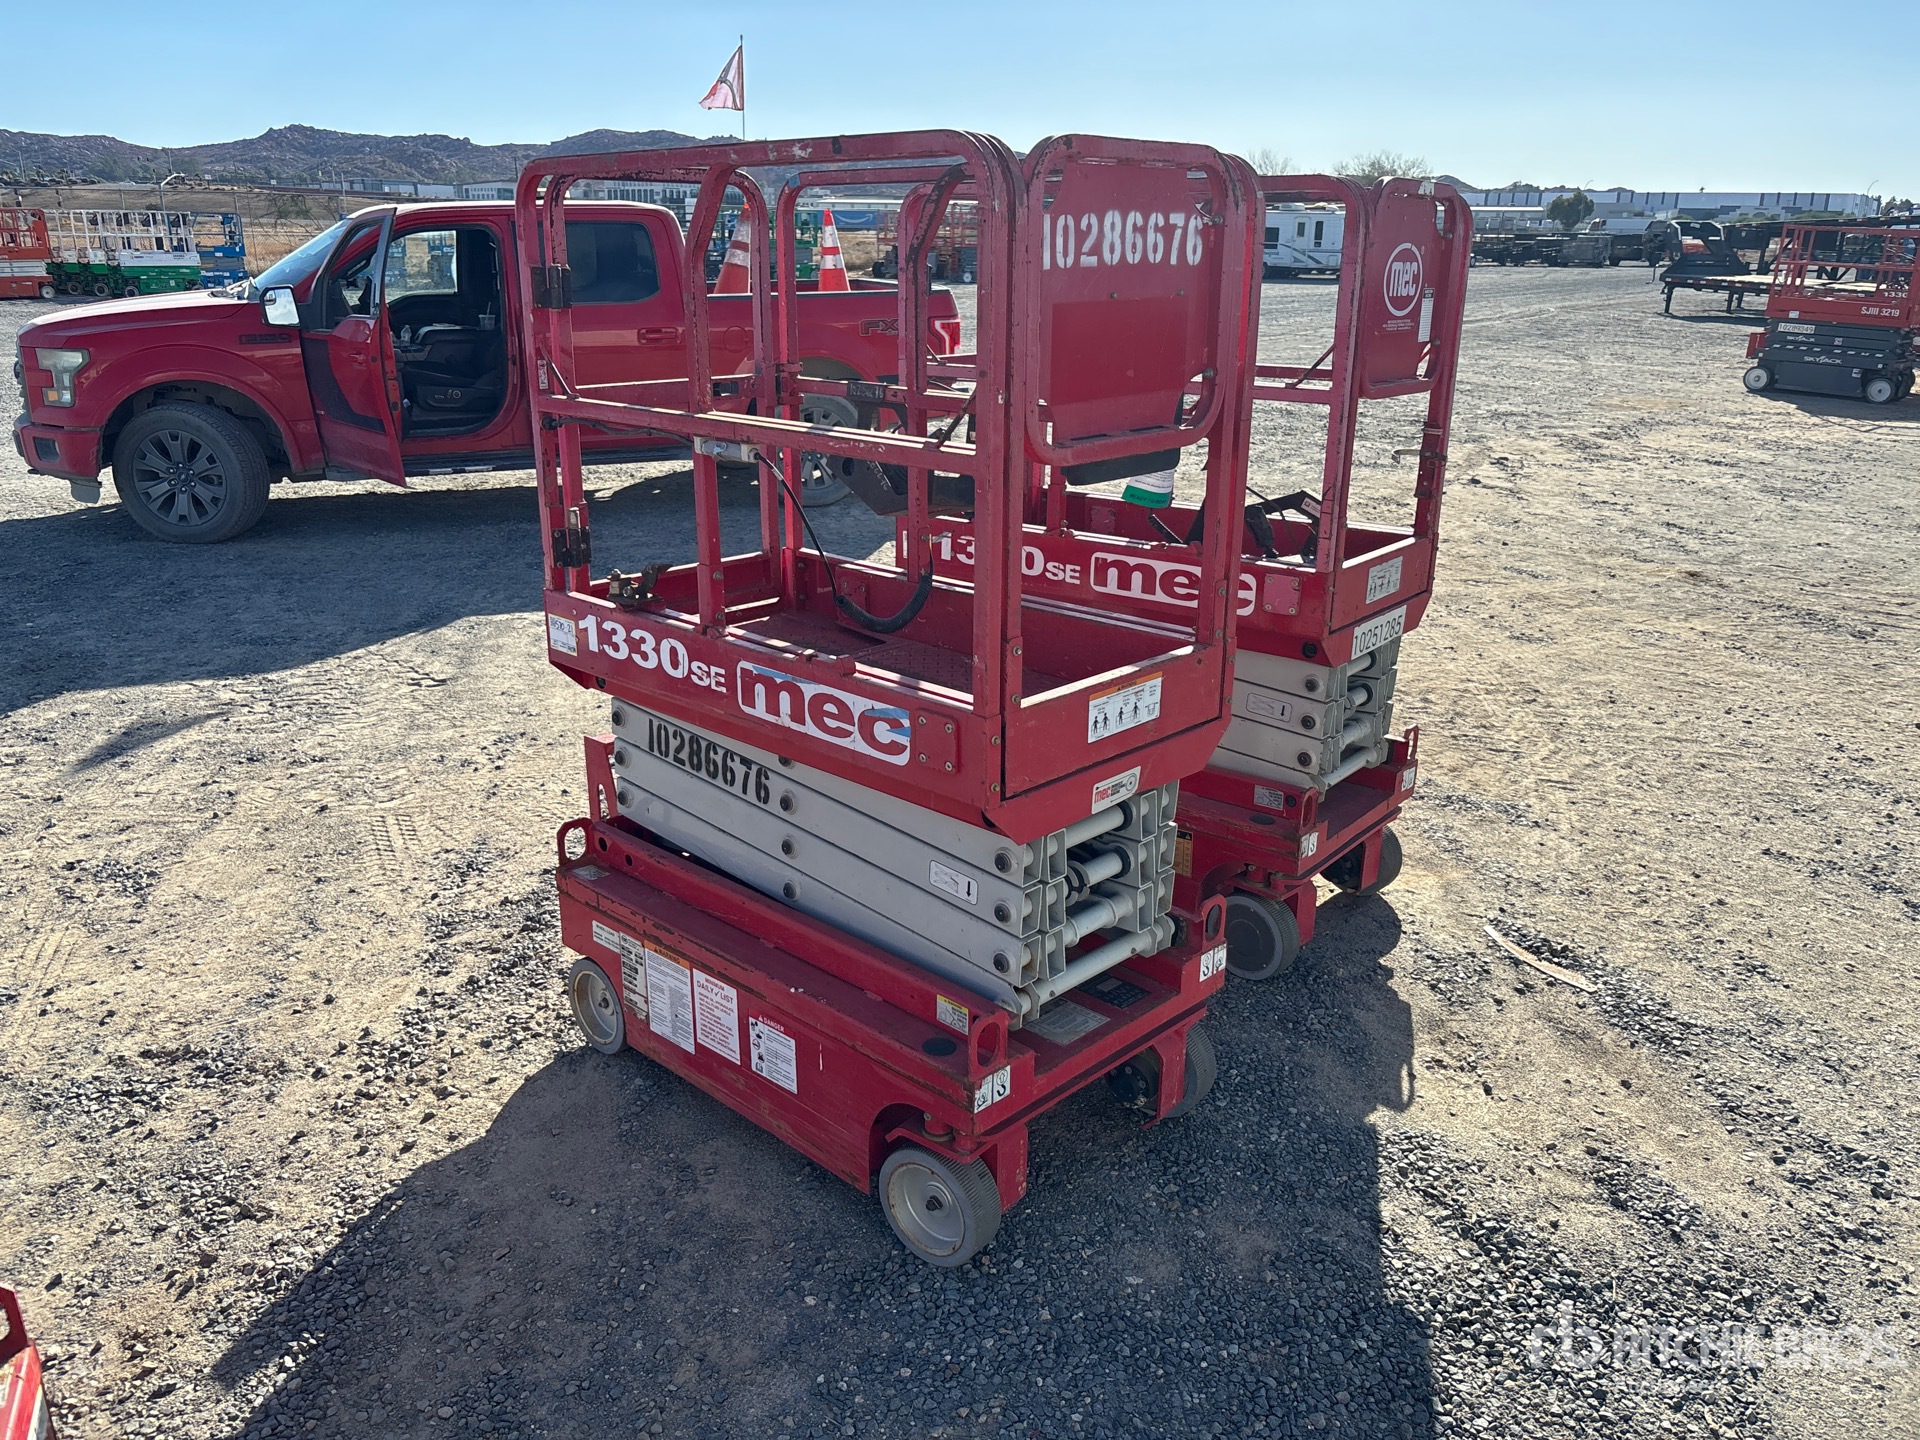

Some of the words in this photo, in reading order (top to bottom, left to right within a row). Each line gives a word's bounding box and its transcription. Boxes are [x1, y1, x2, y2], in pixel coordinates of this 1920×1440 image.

[1043, 210, 1203, 270] 10286676
[1880, 308, 1900, 317] 3219
[1354, 615, 1403, 656] 10251285
[740, 667, 908, 757] mec
[648, 718, 770, 805] 10286676
[696, 980, 714, 994] DAILY
[720, 992, 734, 1005] LIST
[764, 1017, 784, 1033] DANGER
